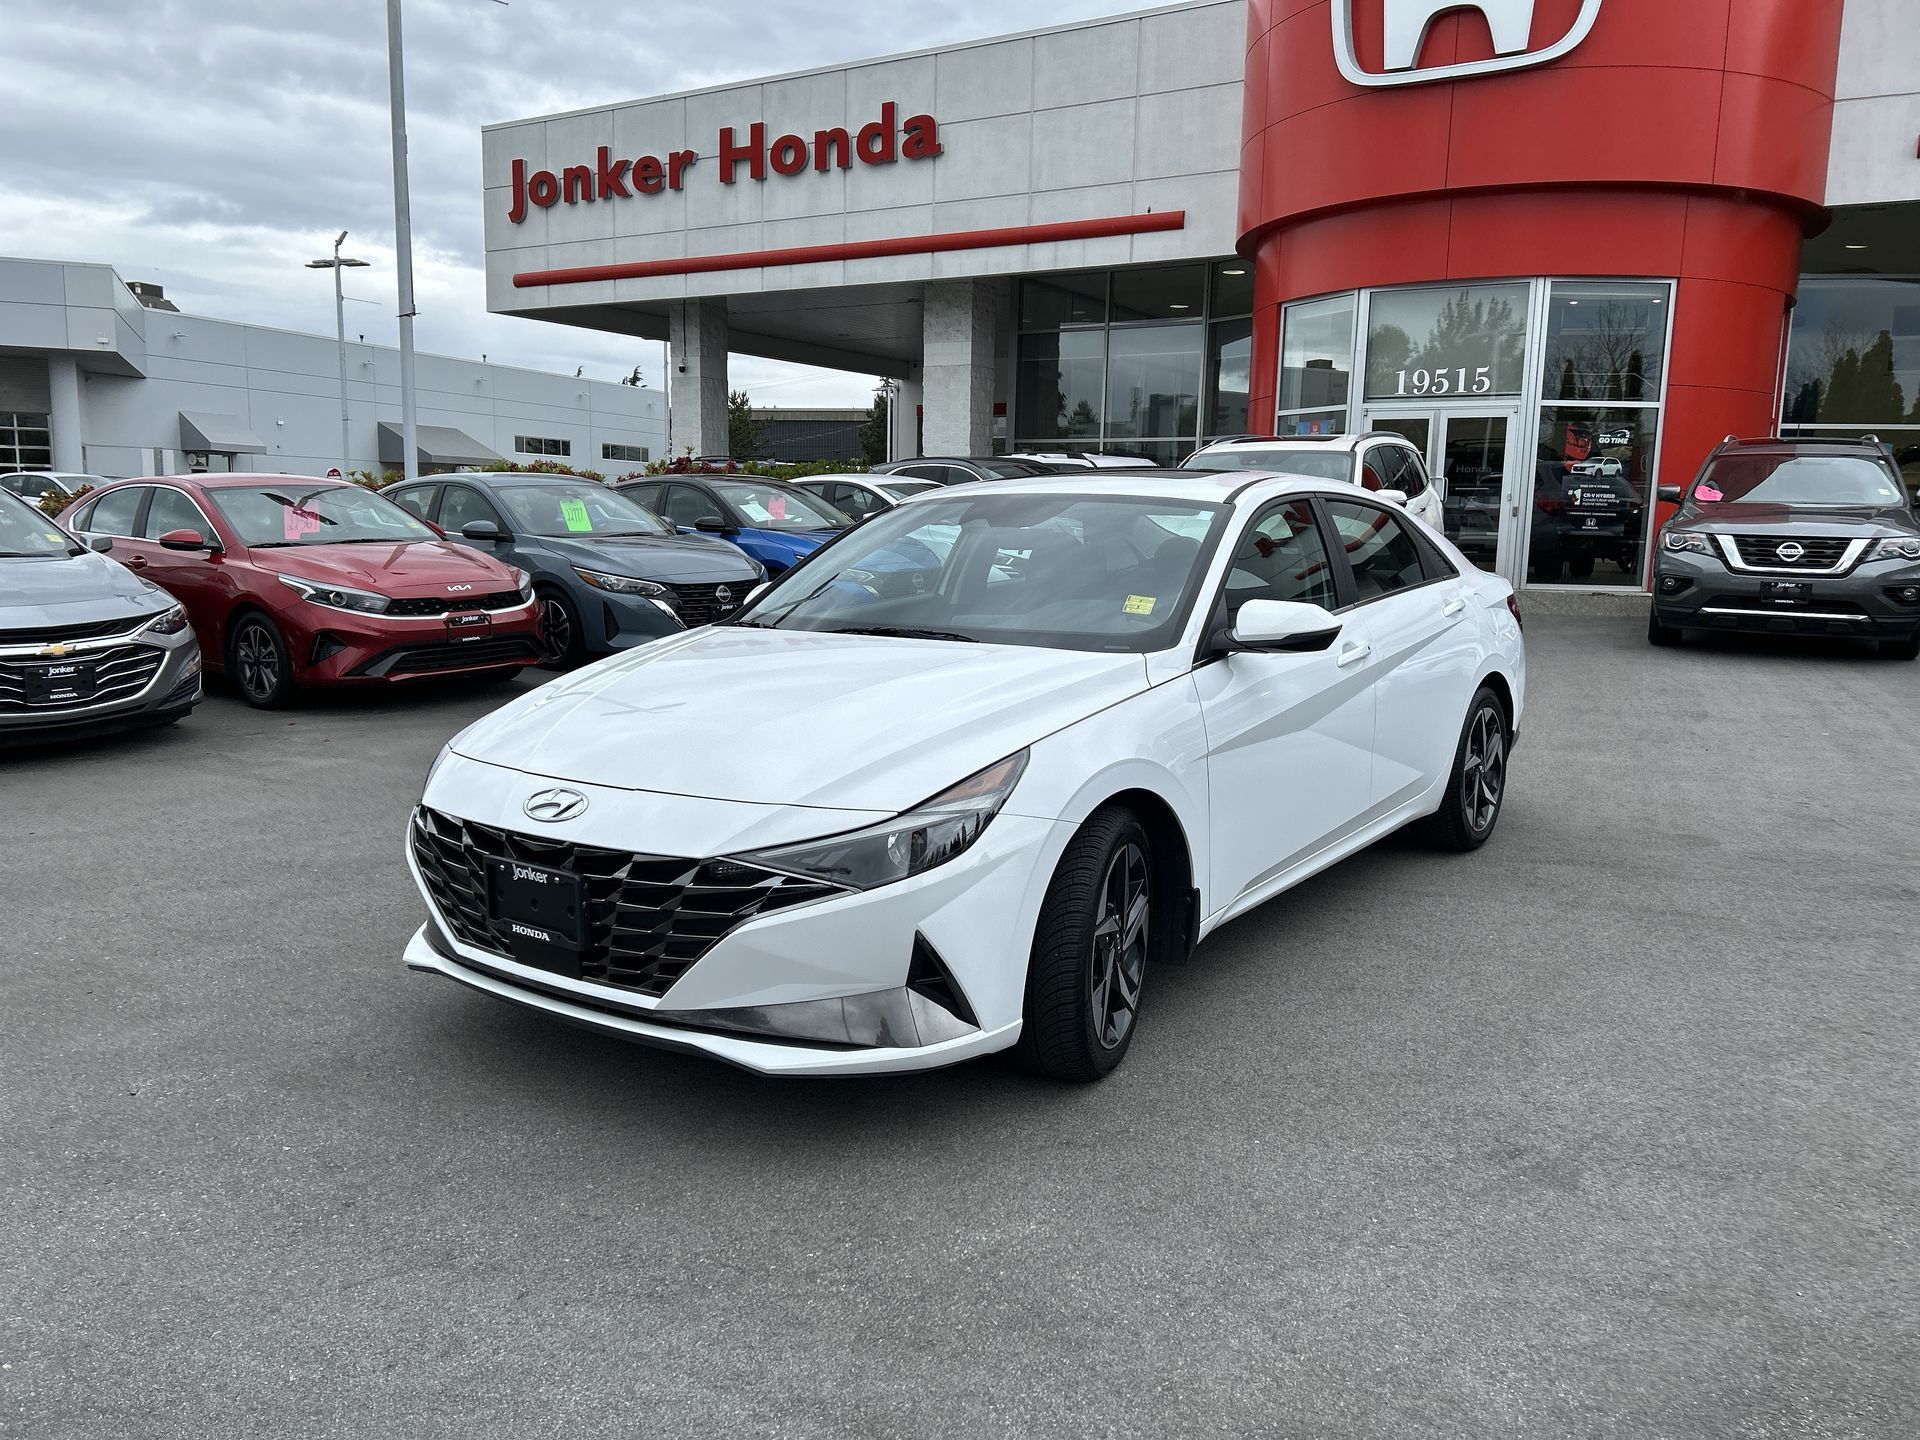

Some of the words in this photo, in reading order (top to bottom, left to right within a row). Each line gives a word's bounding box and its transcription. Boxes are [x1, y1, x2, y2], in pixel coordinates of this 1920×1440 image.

[508, 145, 698, 224] Jonker
[719, 100, 944, 184] Honda
[1394, 365, 1491, 396] 19515
[1598, 437, 1611, 445] GO
[1611, 437, 1629, 445] TIME
[461, 615, 479, 624] Jonker
[47, 665, 76, 677] Jonker
[511, 863, 548, 884] Jonker
[511, 923, 551, 942] HONDA
